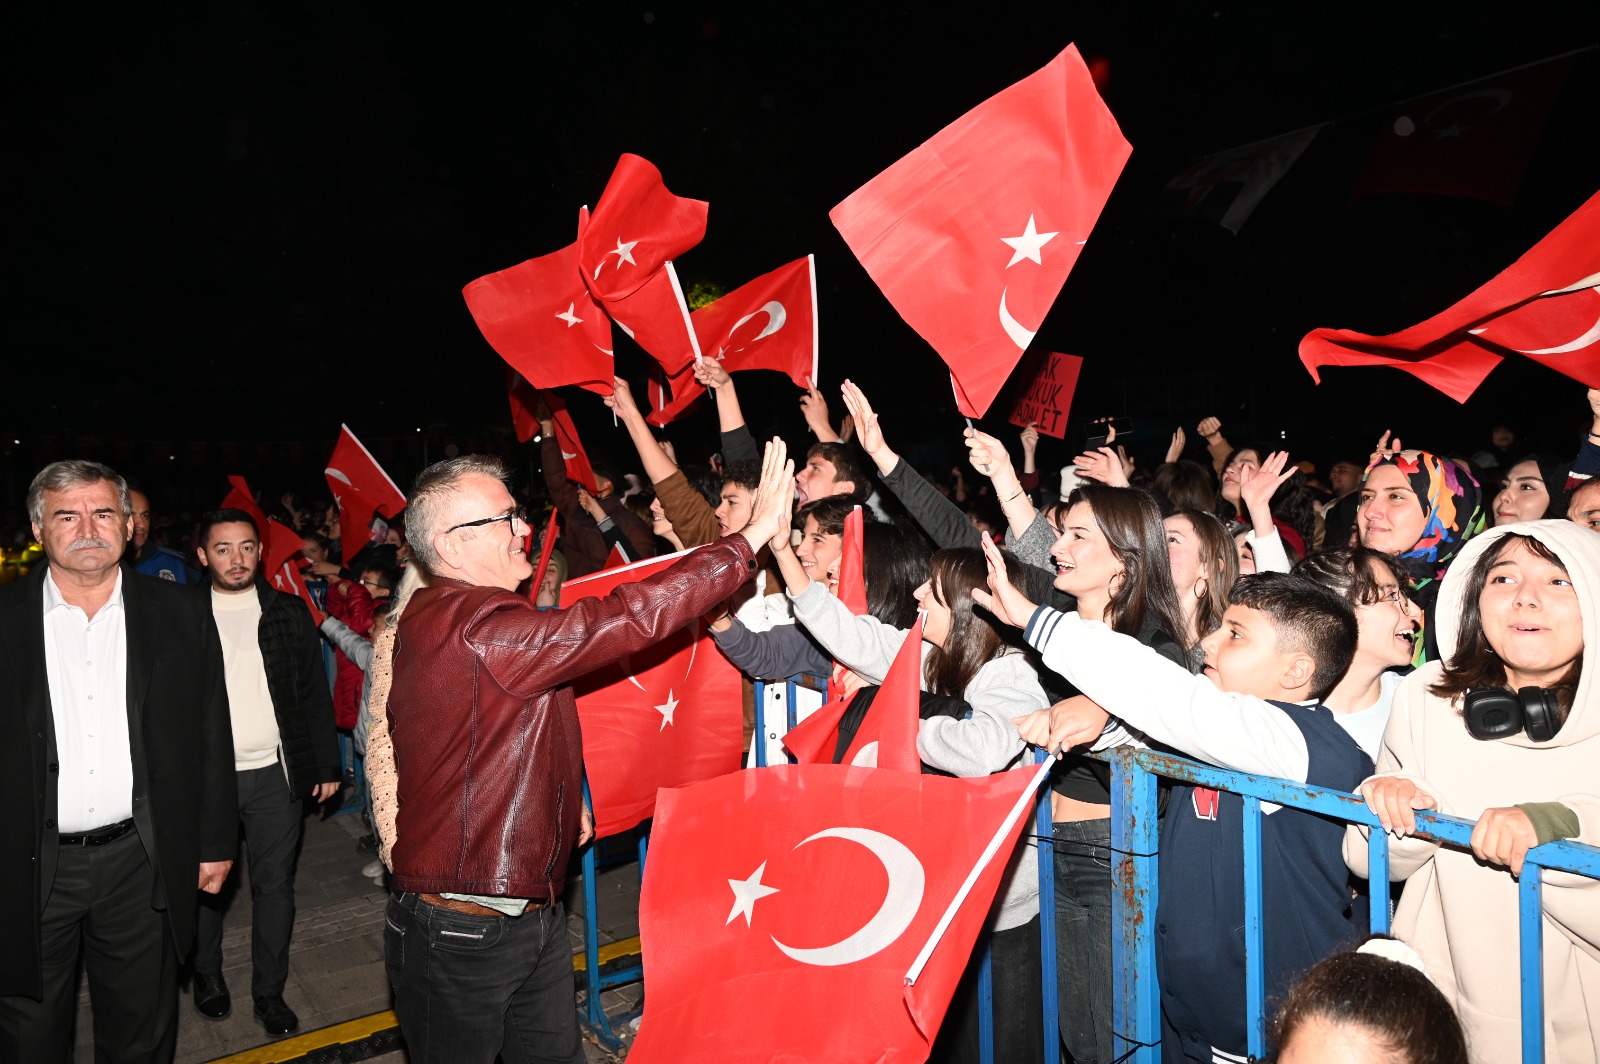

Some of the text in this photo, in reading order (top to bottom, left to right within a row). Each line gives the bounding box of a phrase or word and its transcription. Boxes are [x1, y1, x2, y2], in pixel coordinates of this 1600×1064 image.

[1038, 356, 1062, 382] AK
[1025, 380, 1063, 409] UKUK
[1014, 402, 1063, 433] ADALET
